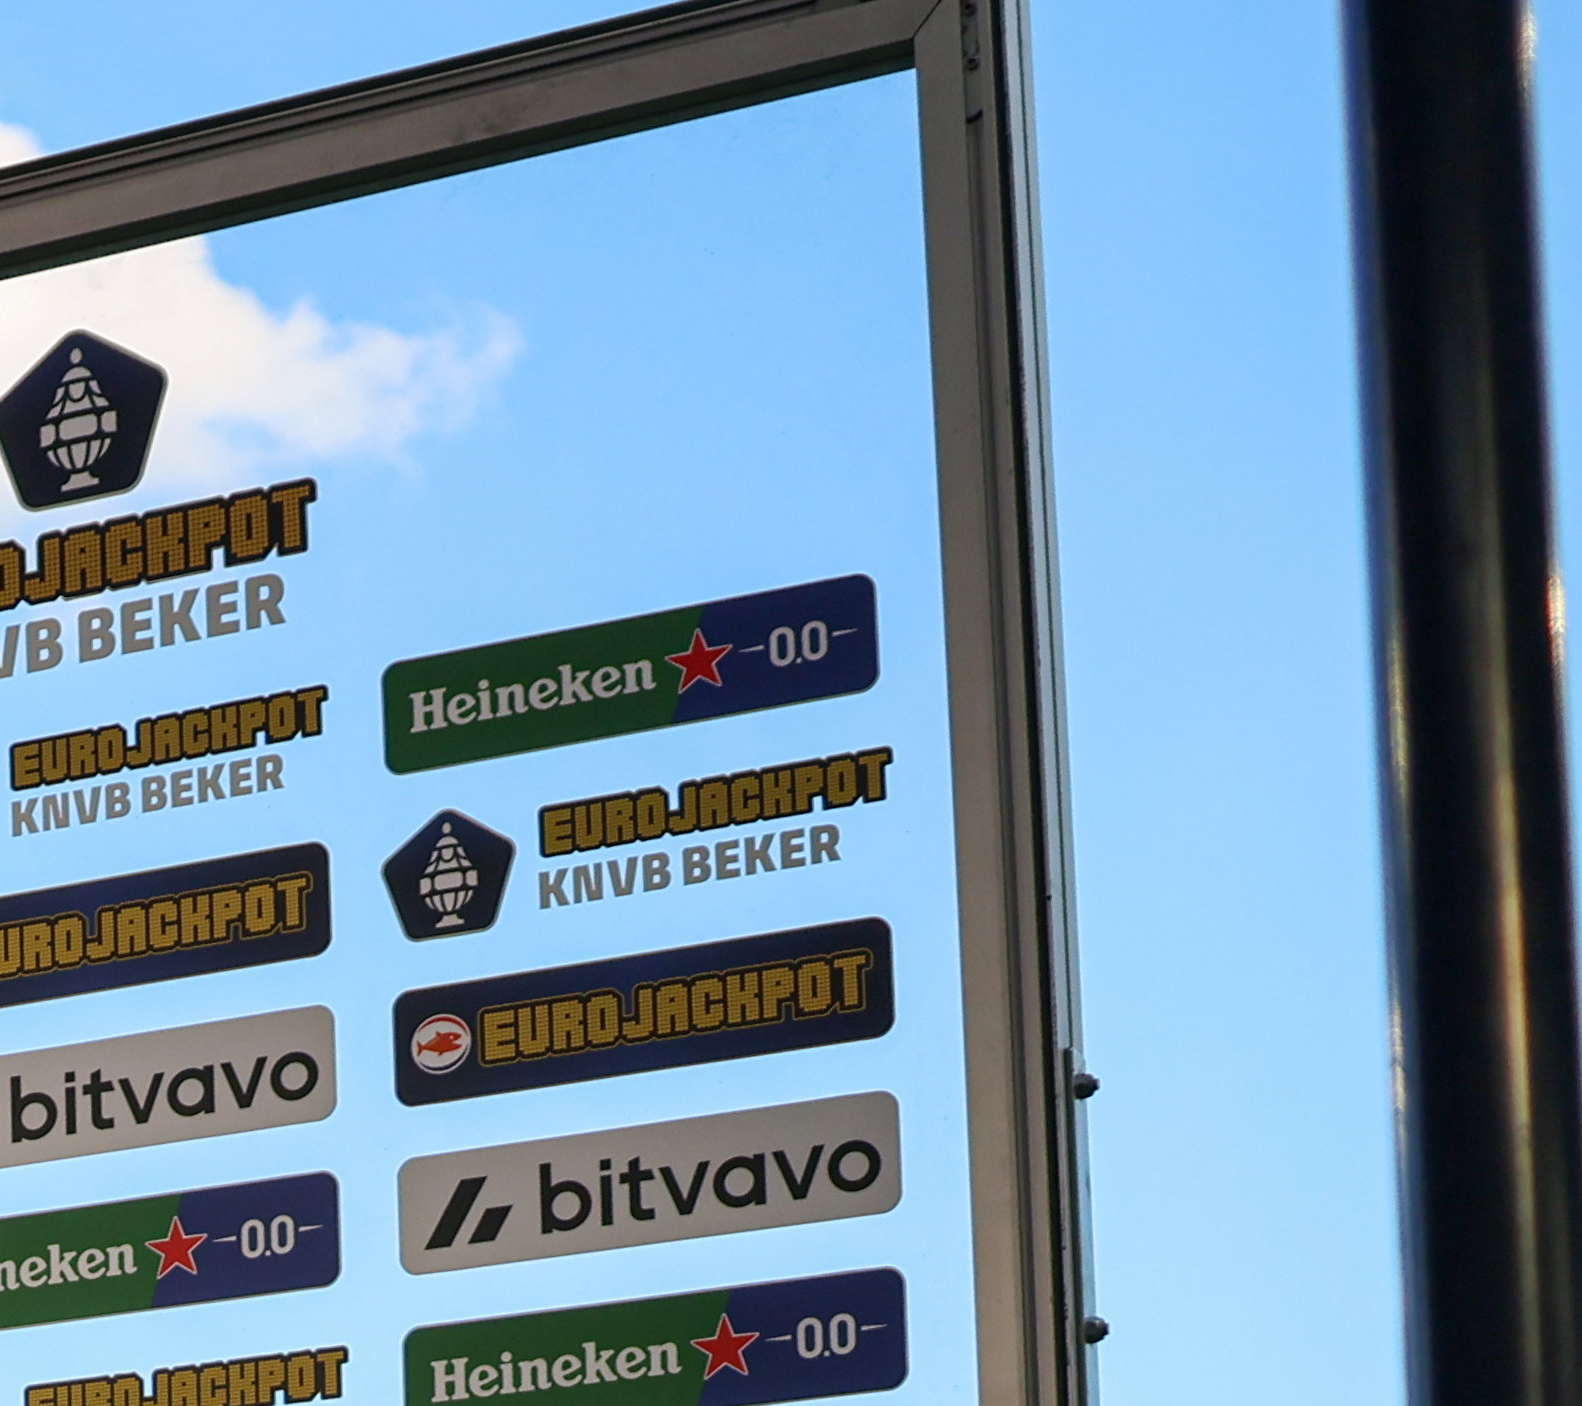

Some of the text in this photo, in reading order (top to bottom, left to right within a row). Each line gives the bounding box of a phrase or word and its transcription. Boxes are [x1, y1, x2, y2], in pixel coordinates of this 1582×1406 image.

[77, 573, 287, 663] BEKER
[408, 619, 830, 734] Heineken 0.0
[10, 685, 329, 790] EUROJACKPOT
[10, 753, 285, 837] KNVB BEKER
[537, 745, 893, 858] EUROJACKPOT
[538, 822, 842, 910] KNVB BEKER
[478, 949, 873, 1066] EUROJACKPOT
[10, 1051, 319, 1144] bitvavo
[538, 1138, 882, 1235] bitvavo
[240, 1214, 296, 1259] 0.0
[430, 1312, 857, 1403] Heineken 0.0
